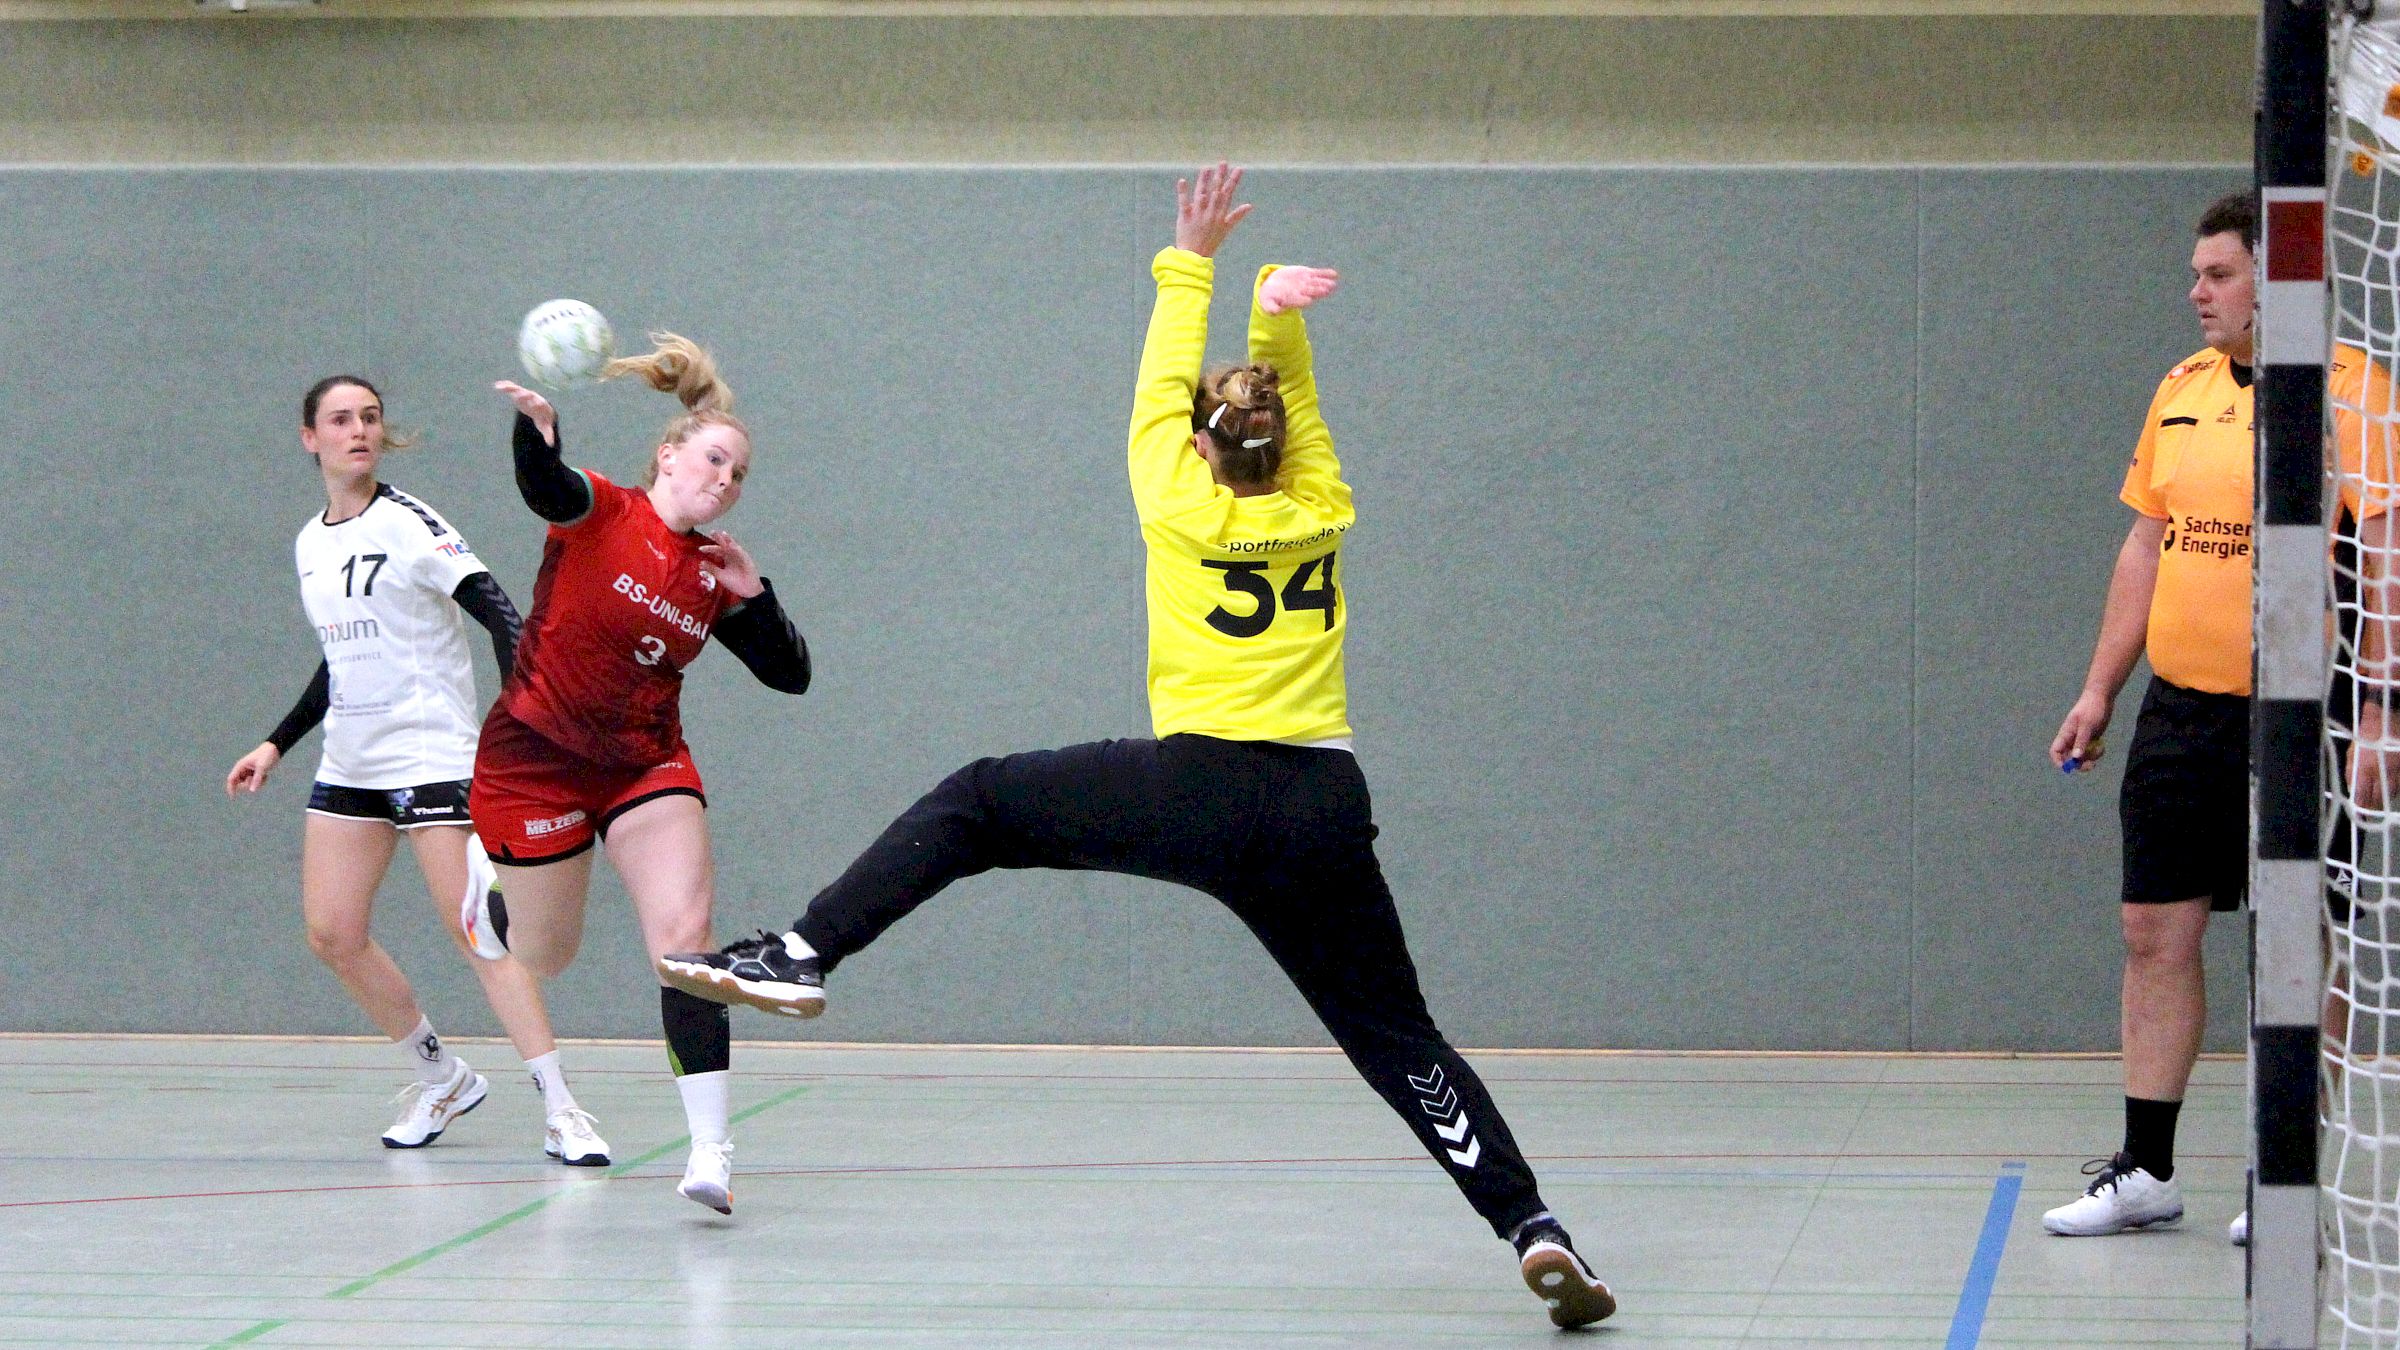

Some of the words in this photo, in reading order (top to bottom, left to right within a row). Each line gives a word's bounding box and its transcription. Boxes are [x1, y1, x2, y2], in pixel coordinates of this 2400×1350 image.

[2181, 536, 2249, 559] Energie
[340, 553, 388, 598] 17
[1201, 551, 1337, 638] 34
[634, 634, 666, 666] 3
